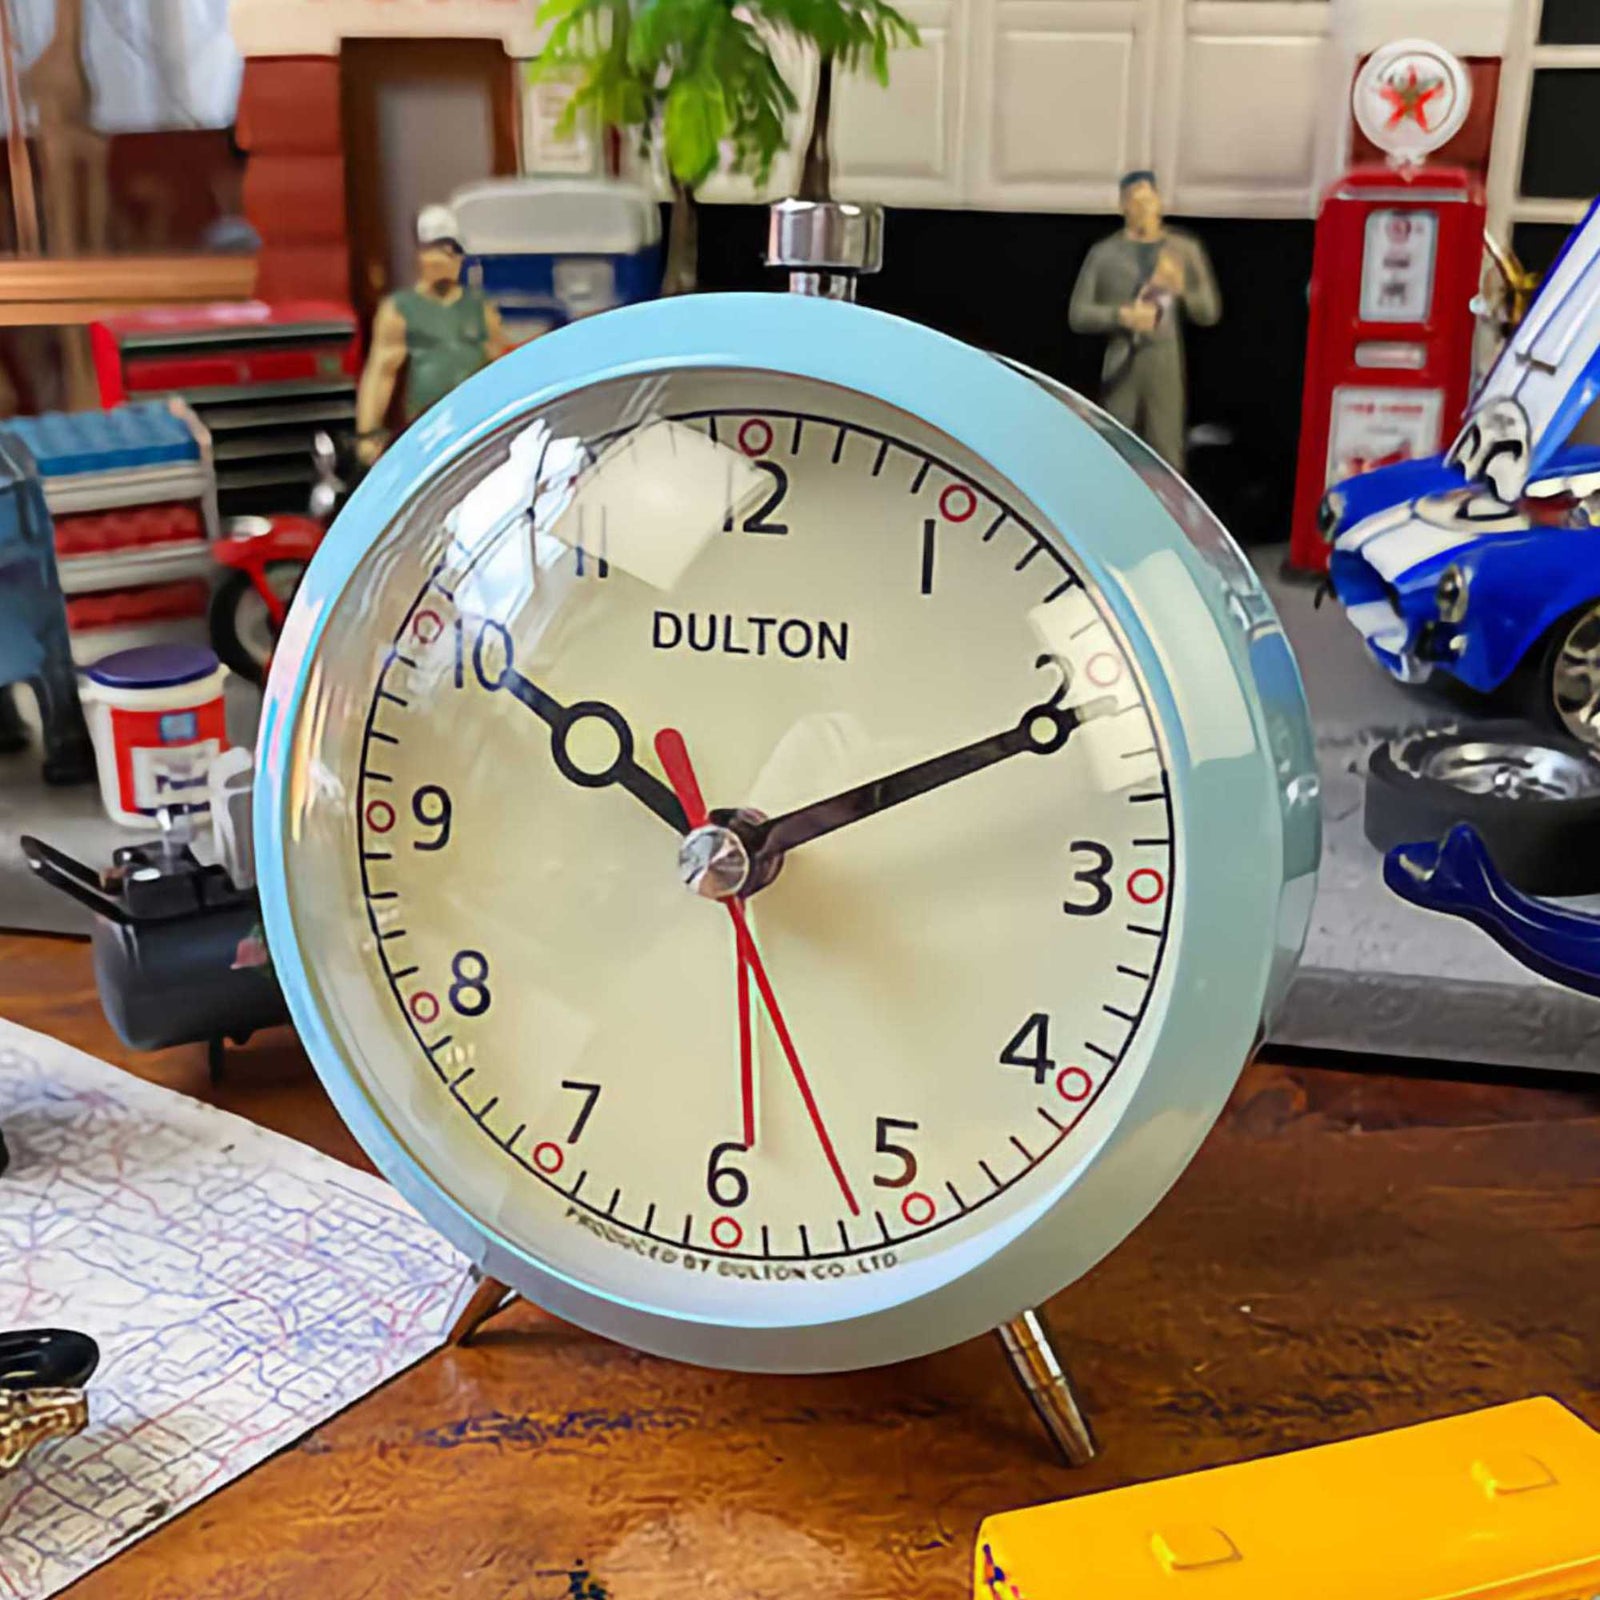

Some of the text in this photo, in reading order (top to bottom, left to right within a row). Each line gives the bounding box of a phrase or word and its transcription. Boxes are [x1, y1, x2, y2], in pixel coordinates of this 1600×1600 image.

[723, 460, 788, 535] 12
[576, 505, 608, 578] 11
[922, 519, 935, 594] 1
[455, 618, 513, 692] 10
[652, 611, 848, 661] DULTON
[412, 785, 452, 851] 9
[1063, 840, 1113, 916] 3
[449, 949, 491, 1017] 8
[999, 1013, 1056, 1085] 4
[561, 1080, 600, 1144] 7
[707, 1142, 749, 1207] 6
[873, 1116, 918, 1188] 5
